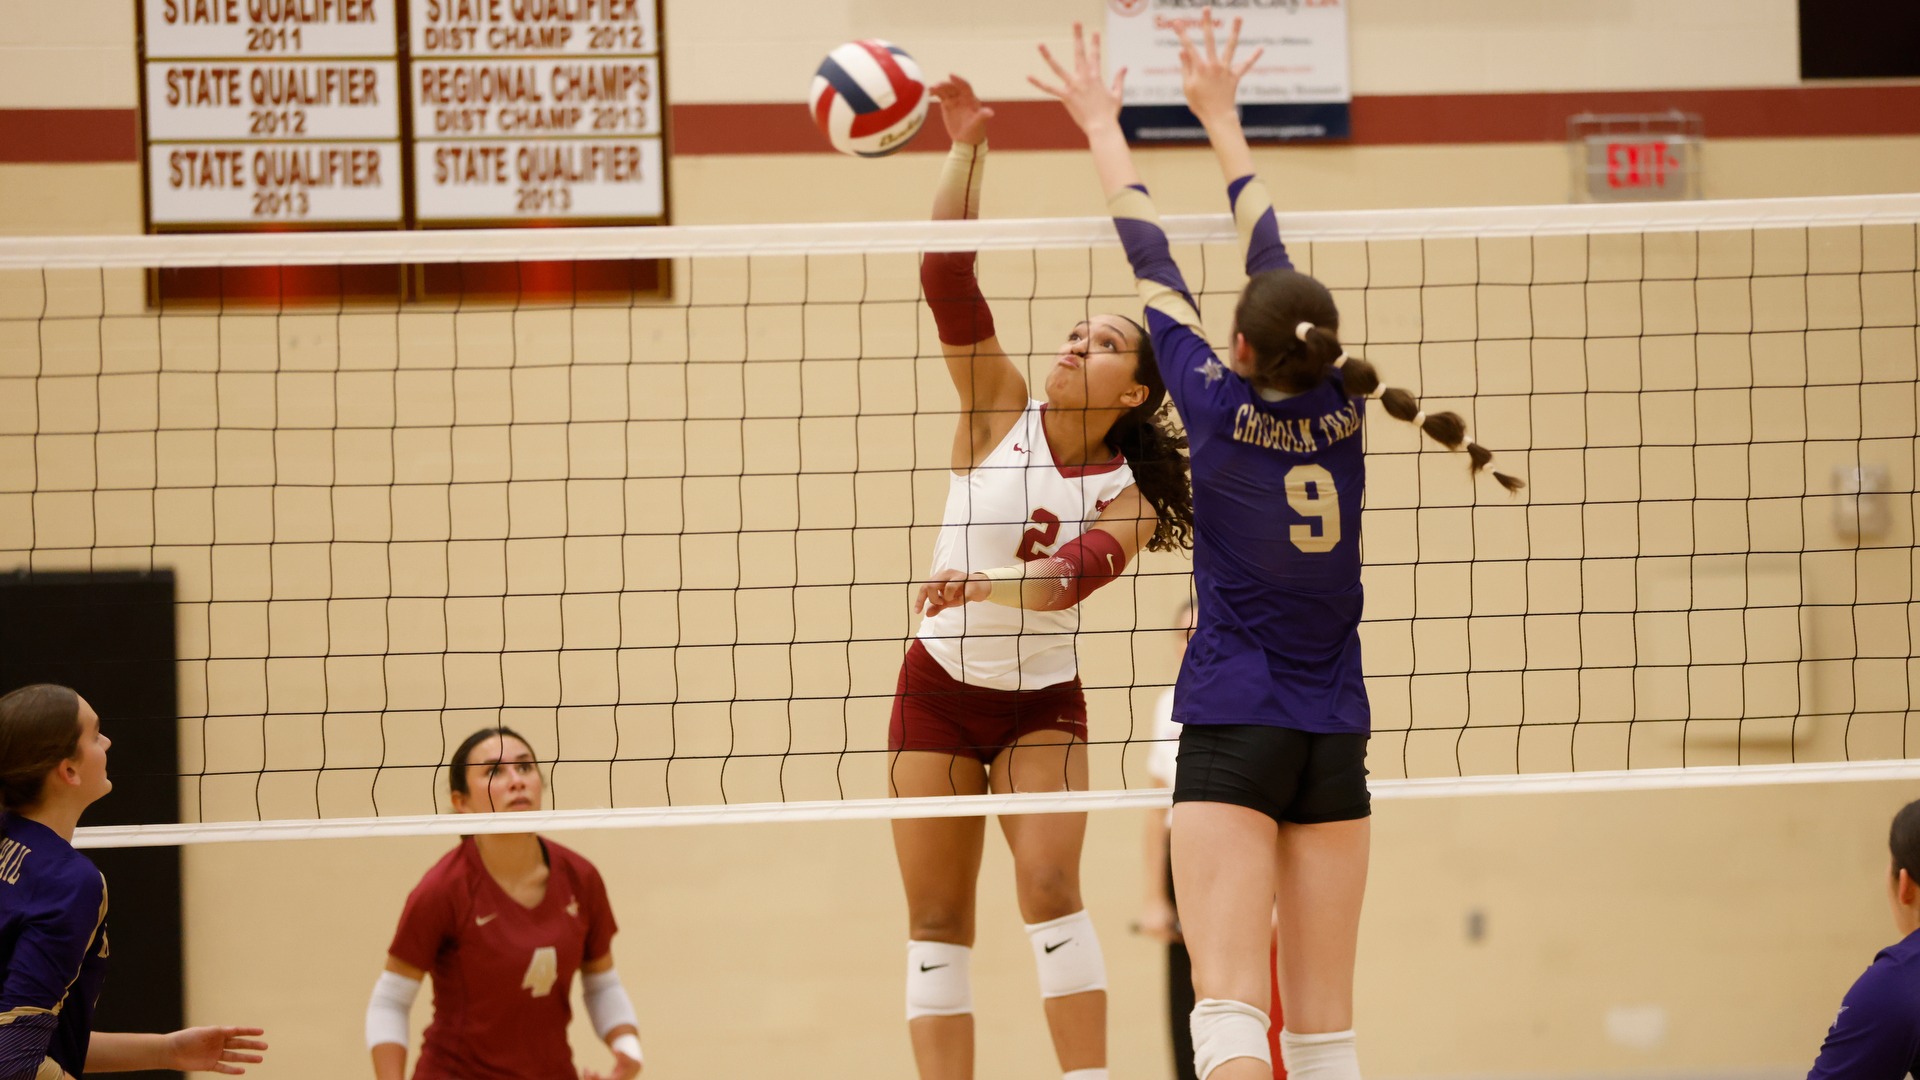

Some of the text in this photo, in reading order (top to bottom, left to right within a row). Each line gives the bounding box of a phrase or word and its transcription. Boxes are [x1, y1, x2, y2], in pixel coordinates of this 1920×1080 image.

[163, 0, 377, 24] STATE QUALIFIER
[426, 0, 639, 23] STATE QUALIFIER
[246, 28, 303, 50] 2011
[424, 26, 644, 50] DIST CHAMP 2012
[166, 67, 378, 107] STATE QUALIFIER
[421, 64, 650, 103] REGIONAL CHAMPS
[249, 110, 306, 134] 2012
[435, 107, 647, 132] DIST CHAMP 2013
[169, 150, 381, 188] STATE QUALIFIER
[434, 146, 643, 184] STATE QUALIFIER
[1606, 142, 1667, 188] EXIT
[252, 191, 310, 215] 2013
[516, 187, 571, 211] 2013
[1233, 403, 1318, 453] CHISHOLM
[1284, 463, 1341, 553] 9
[1014, 506, 1062, 563] 2
[521, 946, 558, 998] 4
